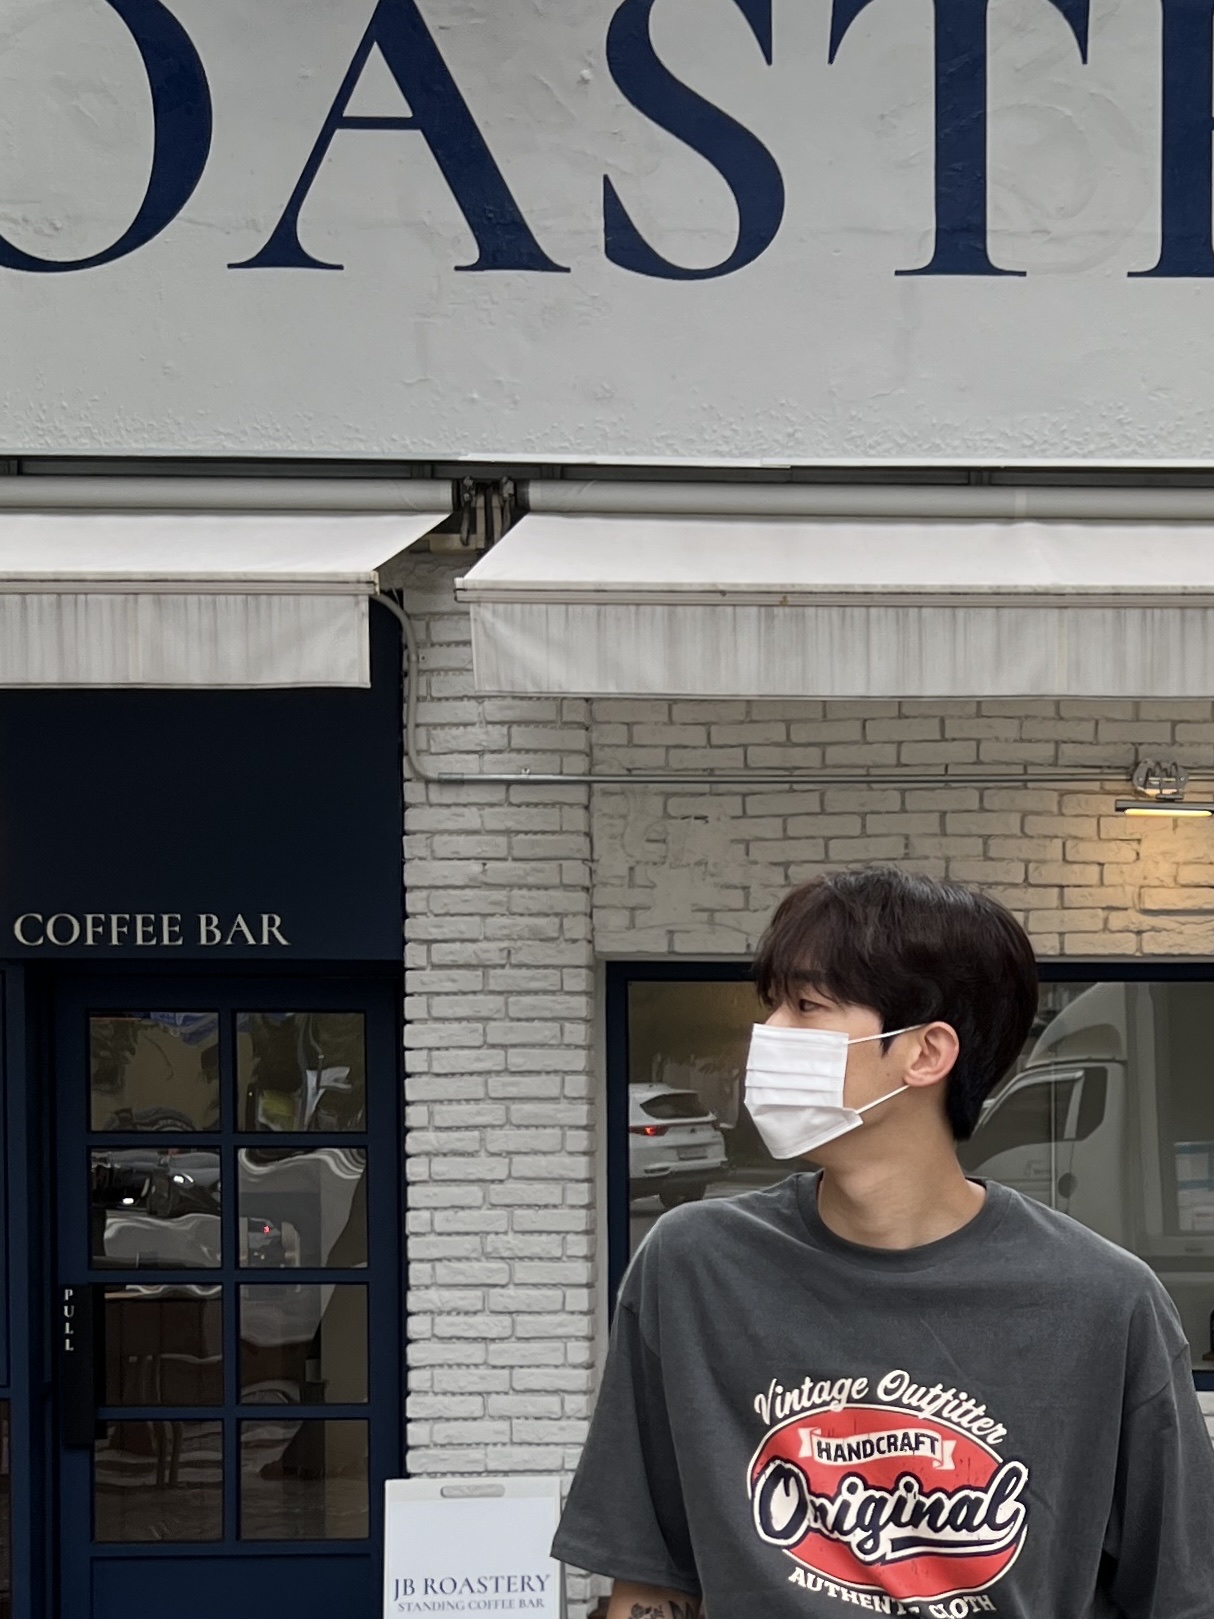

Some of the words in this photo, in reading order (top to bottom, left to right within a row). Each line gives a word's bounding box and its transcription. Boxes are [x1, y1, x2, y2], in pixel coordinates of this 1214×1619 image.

[14, 912, 184, 946] COFFEE
[199, 912, 292, 946] BAR
[63, 1288, 75, 1352] PULL
[754, 1376, 870, 1425] Vintage
[876, 1369, 1008, 1446] Outfitter
[816, 1432, 940, 1463] HANDCRAFT
[754, 1460, 1028, 1560] Original
[394, 1577, 415, 1601] JB
[423, 1574, 551, 1596] ROASTERY
[398, 1600, 466, 1613] STANDING
[468, 1598, 515, 1611] COFFEE
[518, 1597, 545, 1609] BAR
